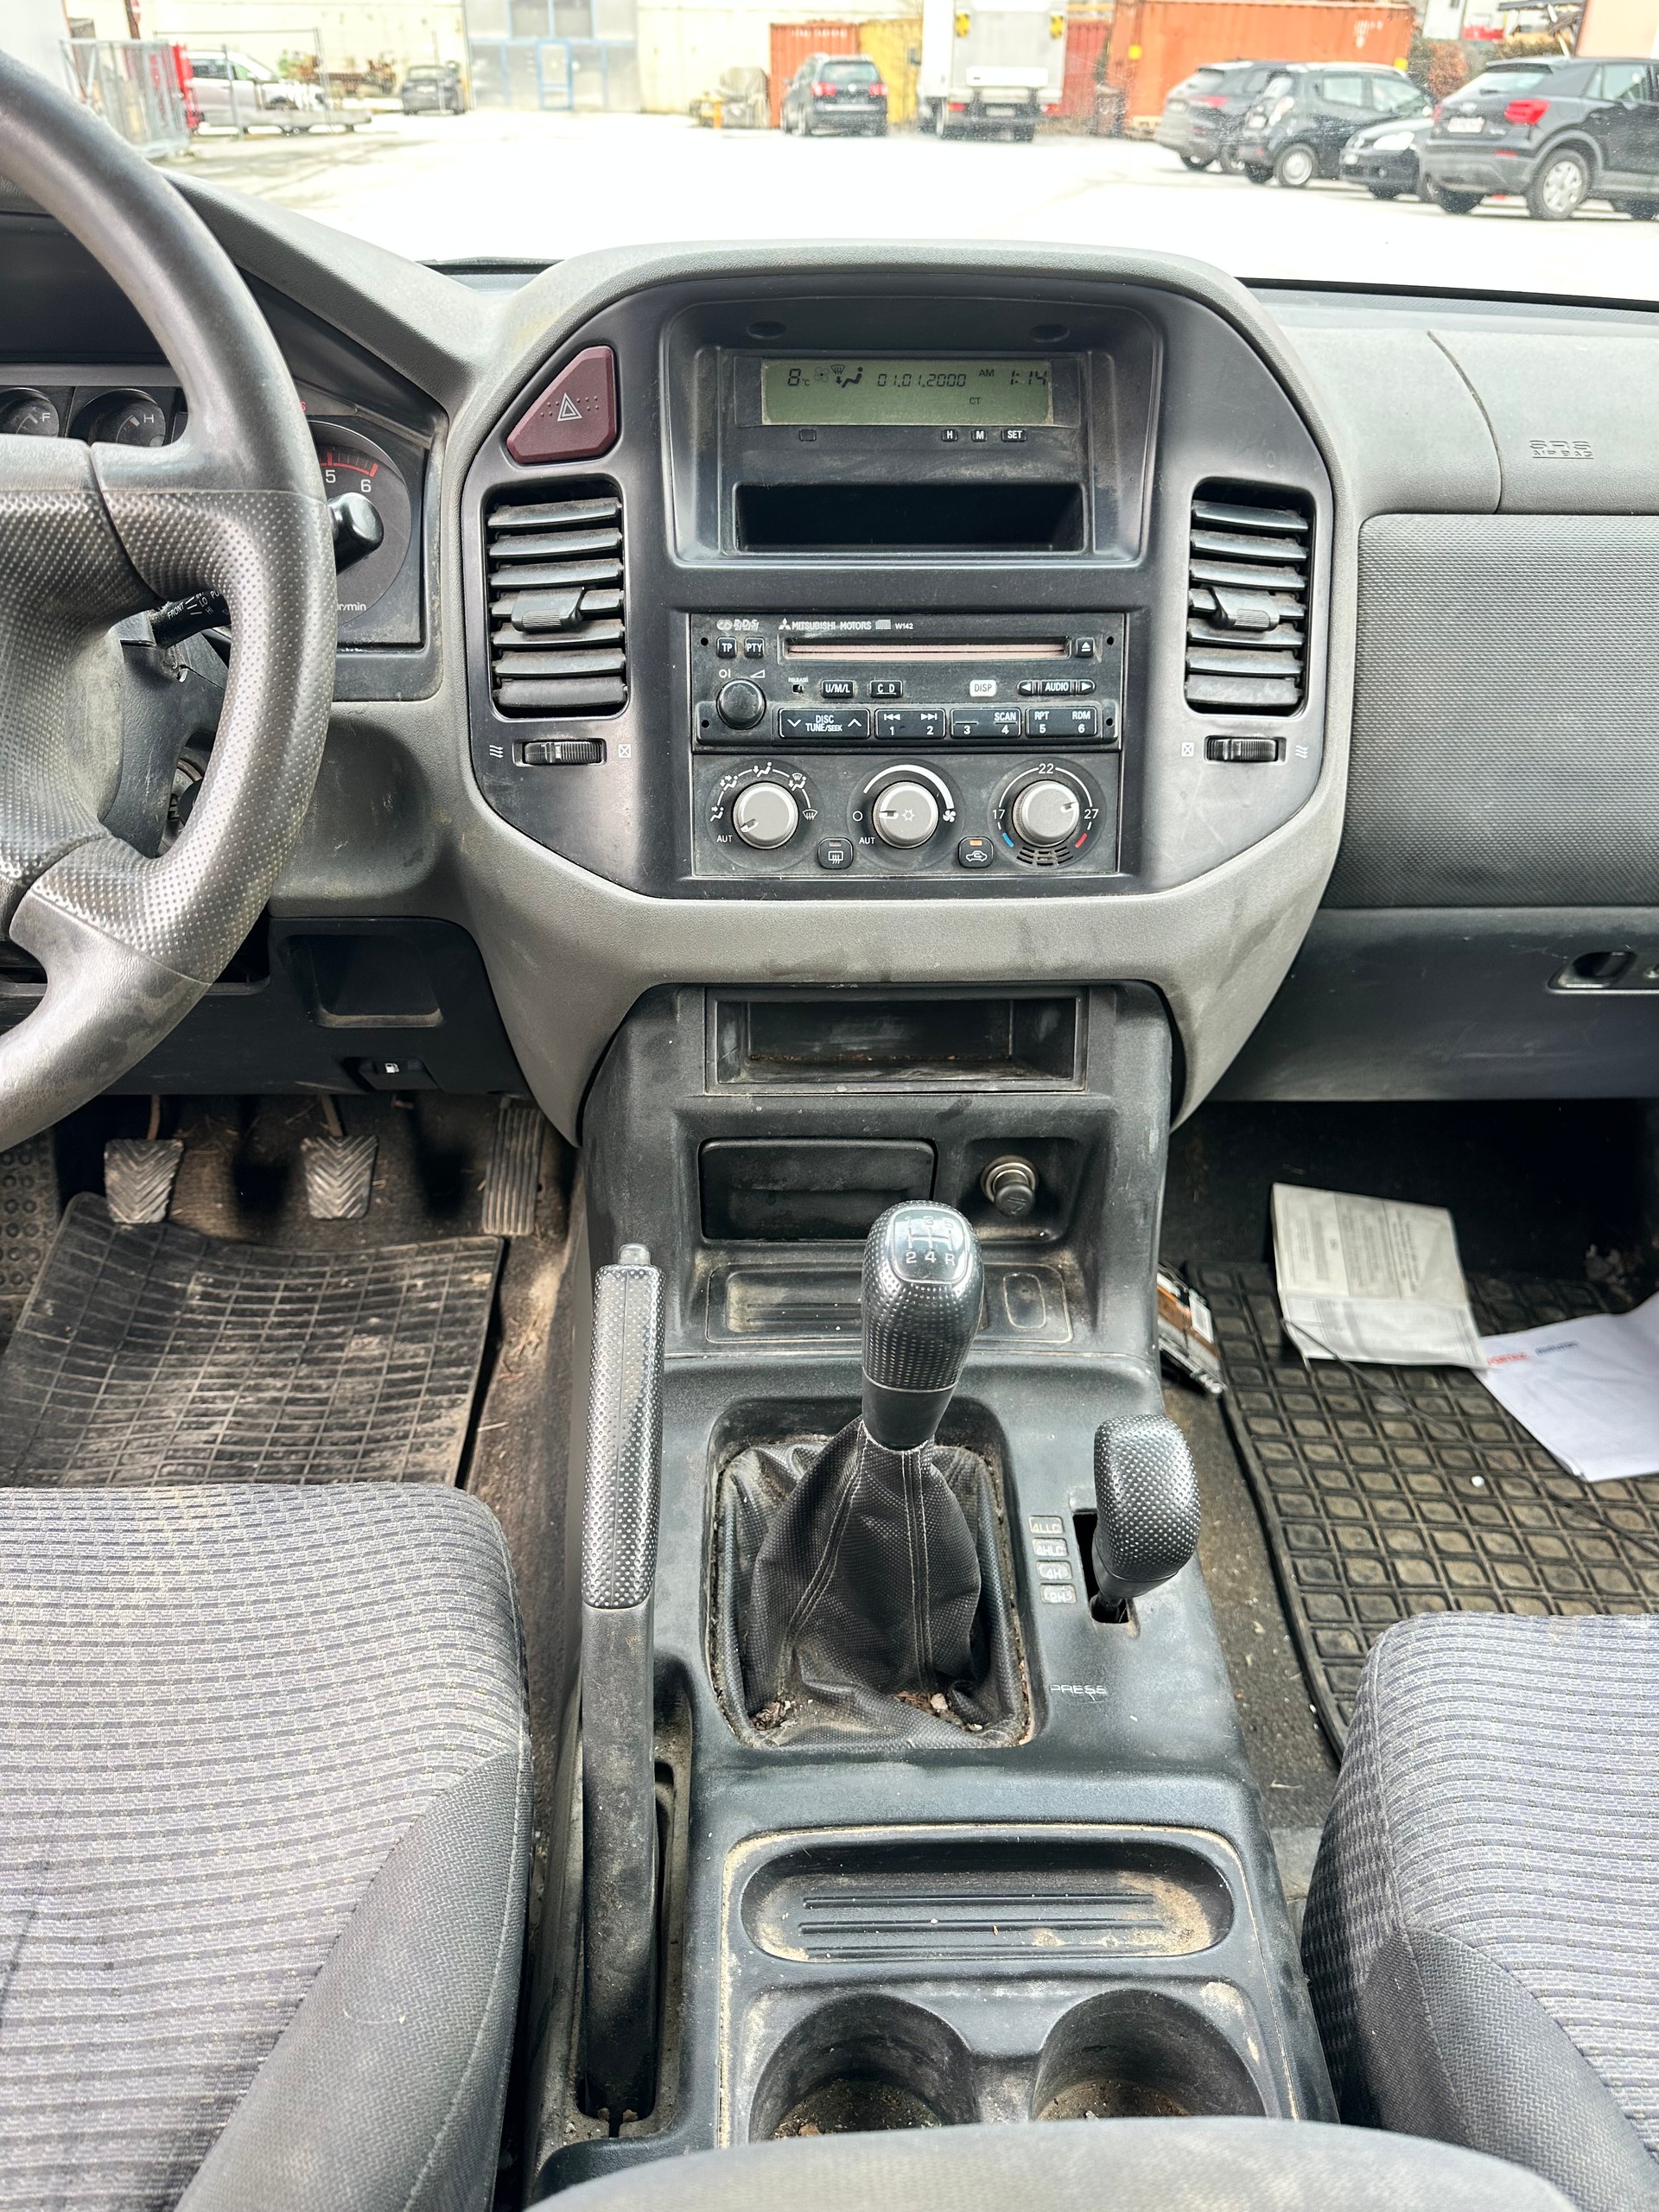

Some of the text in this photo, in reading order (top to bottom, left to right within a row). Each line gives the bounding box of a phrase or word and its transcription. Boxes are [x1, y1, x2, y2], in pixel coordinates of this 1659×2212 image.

[787, 368, 802, 386] 8
[877, 373, 967, 388] 01.01.2000
[1010, 370, 1047, 385] 1:14
[42, 412, 50, 422] F
[143, 414, 155, 423] H
[946, 430, 954, 439] H
[976, 430, 984, 439] M
[1007, 429, 1023, 439] SET
[325, 469, 336, 484] 5
[360, 479, 372, 493] 6
[791, 621, 836, 630] MITSUBISHI
[840, 621, 872, 630] MOTORS
[721, 643, 733, 652] TP
[747, 643, 763, 652] PTY
[825, 683, 851, 693] U/M/L
[974, 683, 993, 692] DISP
[1045, 682, 1070, 692] AUDIO
[815, 715, 835, 724] DISC
[995, 712, 1016, 721] SCAN
[1034, 711, 1049, 720] RPT
[1071, 711, 1090, 720] RDM
[805, 723, 842, 732] TUNE/SEEK
[889, 726, 894, 735] 1
[926, 726, 934, 735] 2
[963, 725, 970, 734] 3
[1001, 725, 1009, 734] 4
[1039, 724, 1046, 734] 5
[1077, 723, 1085, 733] 6
[1038, 763, 1054, 774] 22
[992, 809, 1006, 820] 17
[1084, 809, 1099, 819] 27
[906, 1250, 956, 1267] 2 4 R
[1050, 1685, 1107, 1694] PRESS
